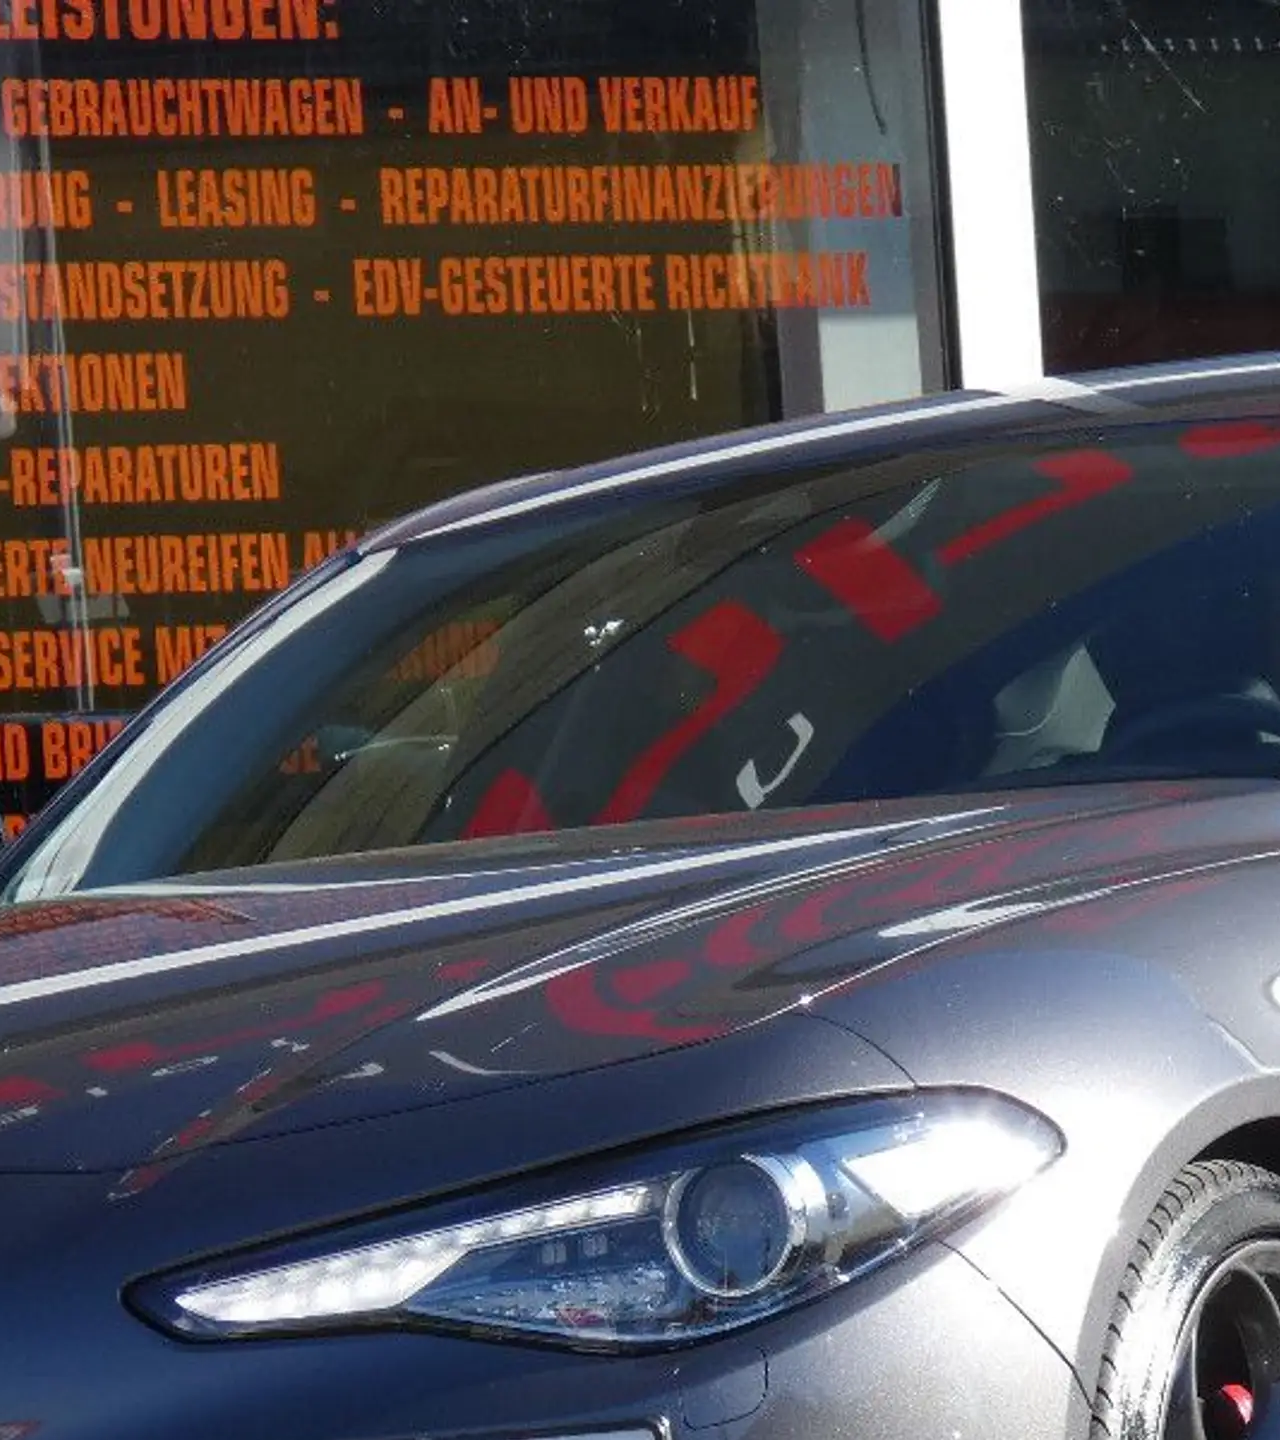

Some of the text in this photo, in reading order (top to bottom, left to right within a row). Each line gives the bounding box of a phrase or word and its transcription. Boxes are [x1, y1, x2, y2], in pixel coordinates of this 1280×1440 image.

[1, 77, 365, 138] GEBRAUCHTWAGEN
[428, 77, 497, 134] AN-
[509, 76, 589, 135] UND
[598, 76, 758, 133] VERKAUF
[156, 168, 317, 228] LEASING
[380, 162, 903, 225] REPARATURFINANZIERUNGEN
[353, 253, 655, 317] EDV-GESTEUERTE
[665, 252, 870, 310] RICHTBANK
[83, 532, 291, 597] NEUREIFEN
